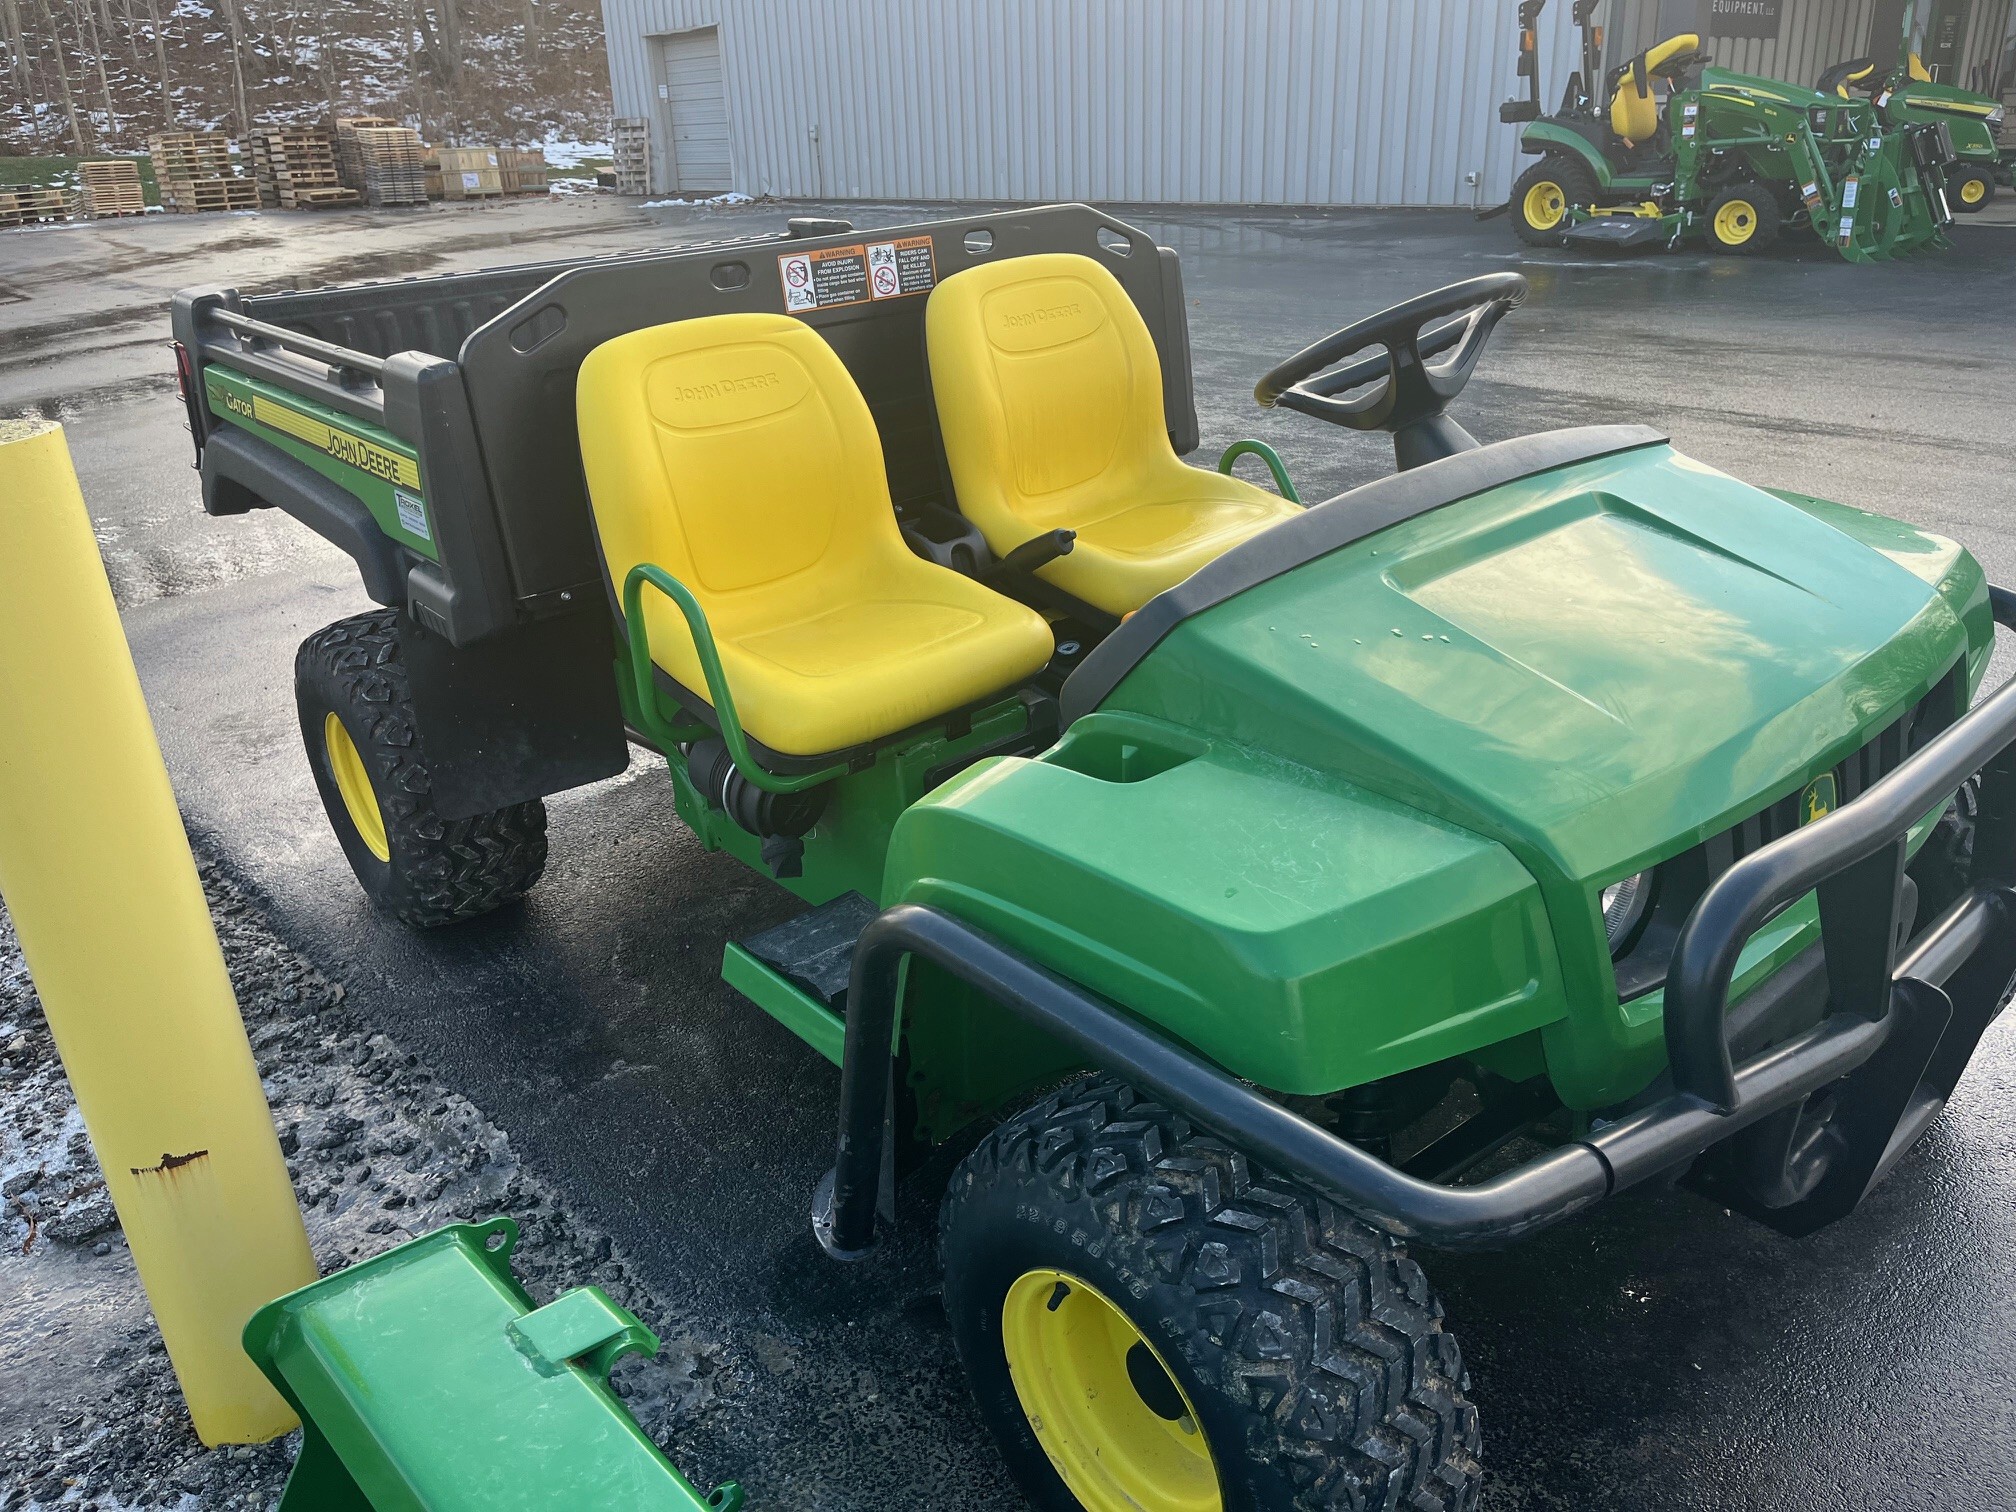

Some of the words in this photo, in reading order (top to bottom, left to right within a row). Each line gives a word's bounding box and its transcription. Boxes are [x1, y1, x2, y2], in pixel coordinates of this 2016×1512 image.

[901, 238, 930, 248] WARNING
[826, 248, 856, 259] WARNING
[900, 249, 917, 257] RIDERS
[837, 258, 854, 266] INJURY
[910, 261, 926, 269] KILLED
[832, 264, 860, 274] EXPLOSION
[1003, 312, 1037, 327] JOHN
[1035, 303, 1081, 320] DEERE
[674, 384, 721, 401] JOHN
[719, 372, 780, 392] DEERE
[226, 391, 253, 419] GATOR
[327, 428, 359, 466] JOHN
[358, 441, 401, 483] DEERE
